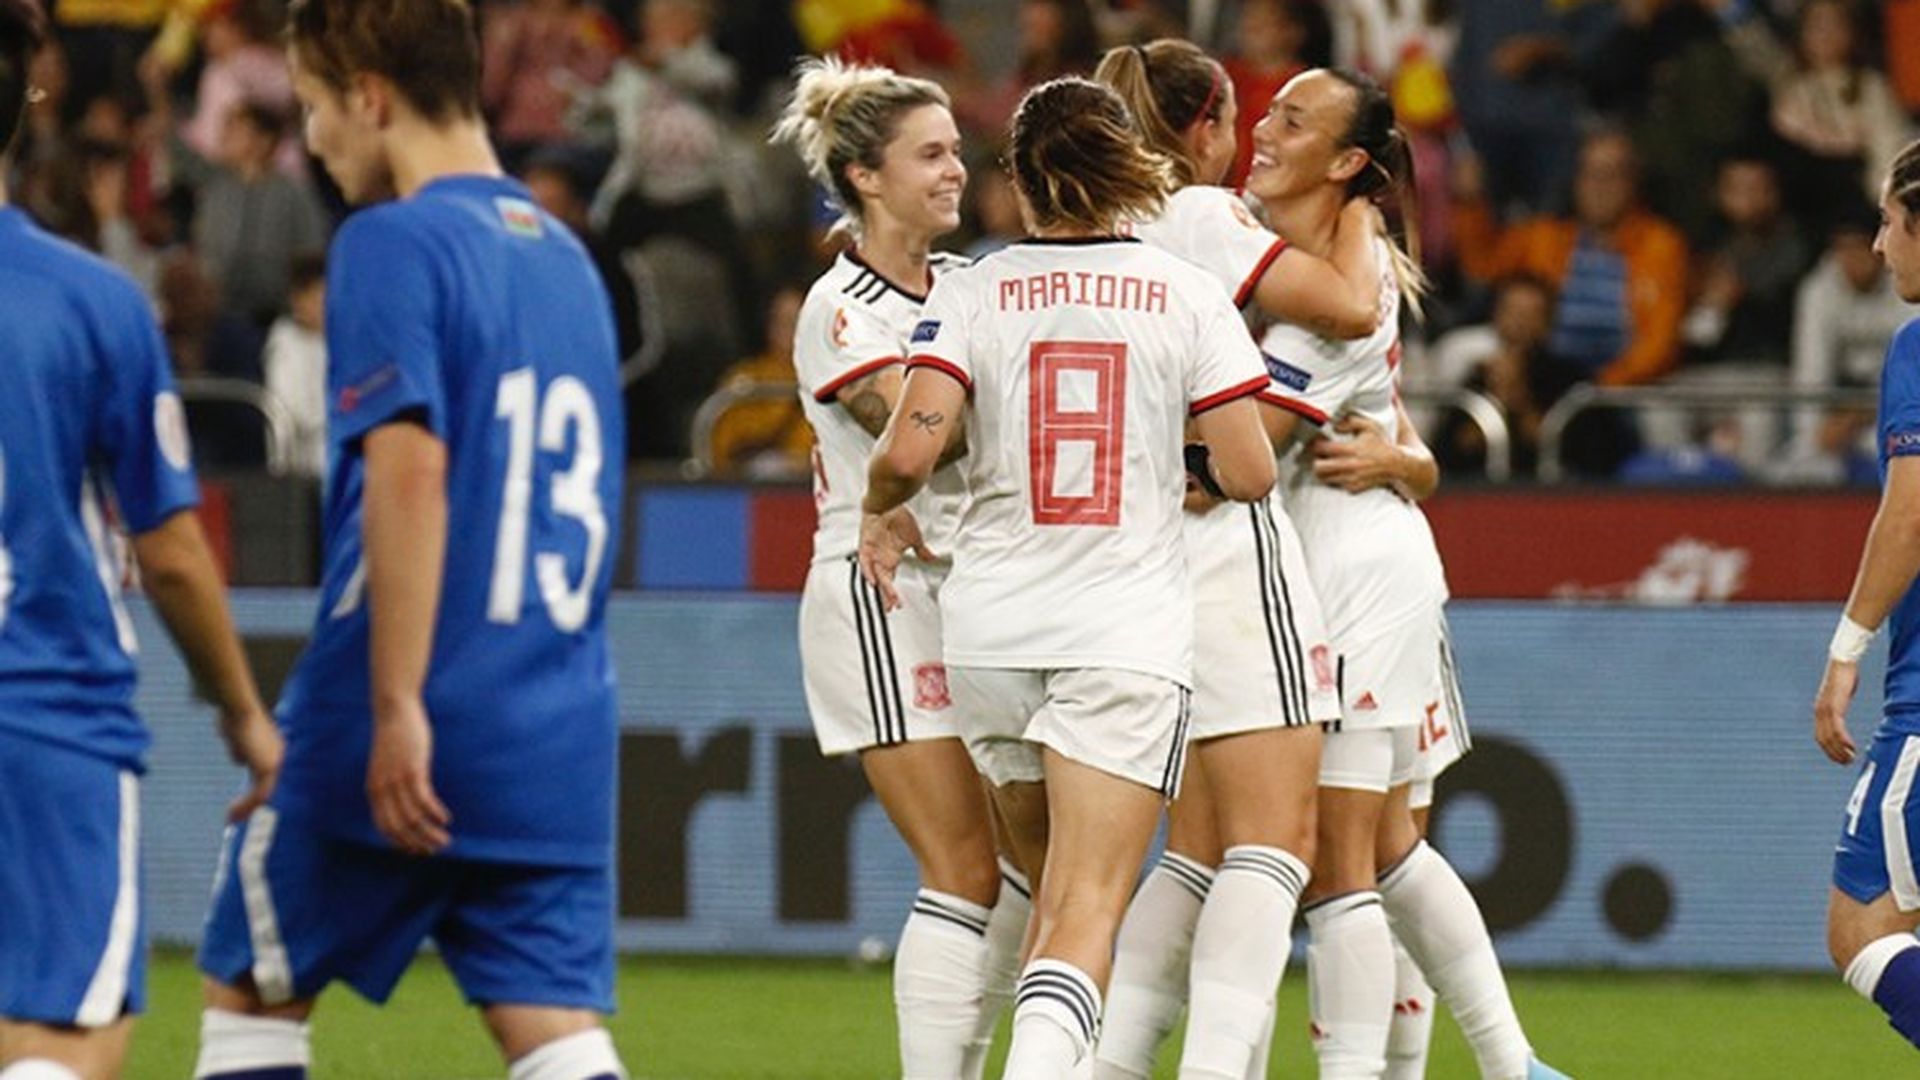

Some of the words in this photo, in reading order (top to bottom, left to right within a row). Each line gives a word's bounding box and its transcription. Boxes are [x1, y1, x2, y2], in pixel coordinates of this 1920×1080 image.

[999, 273, 1168, 315] MARIONA
[488, 368, 608, 632] 13
[1029, 341, 1127, 526] 8
